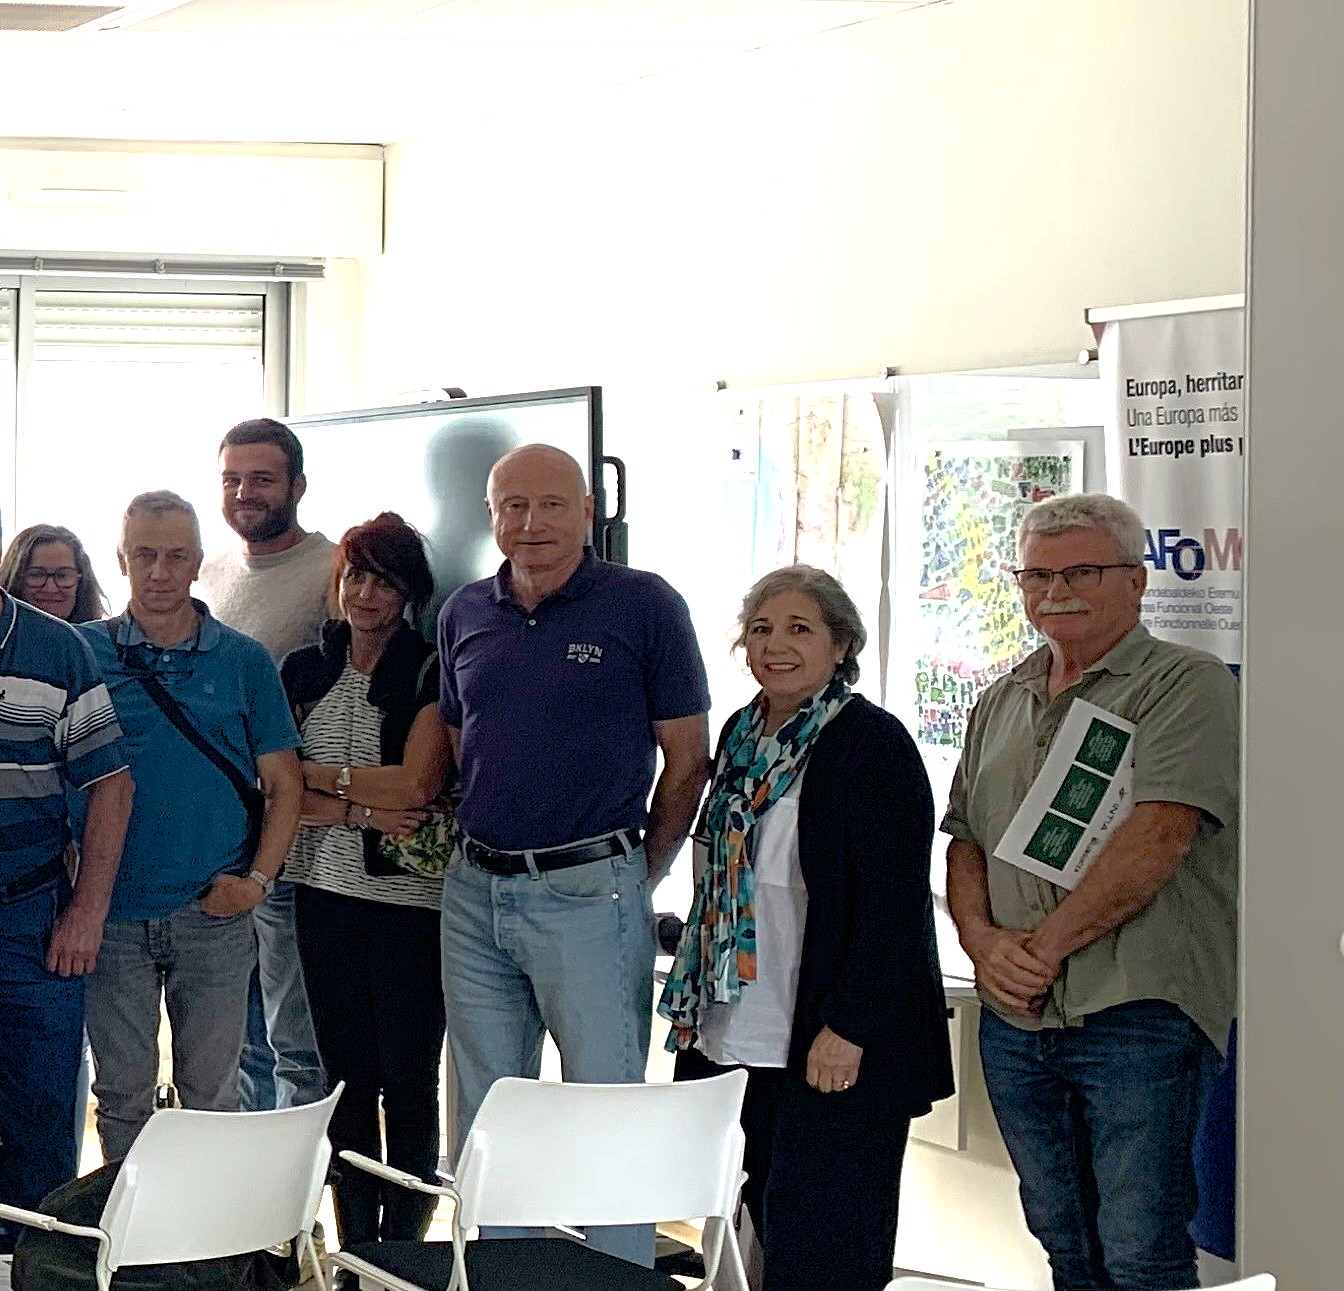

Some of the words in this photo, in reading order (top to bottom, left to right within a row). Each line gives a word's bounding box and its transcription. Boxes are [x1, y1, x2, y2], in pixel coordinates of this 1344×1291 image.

[1126, 378, 1182, 400] Europa,
[1186, 371, 1244, 393] herritar
[1127, 408, 1152, 427] Una
[1156, 406, 1205, 428] Europa
[1209, 401, 1238, 421] más
[1128, 437, 1195, 459] L'Europe
[1200, 434, 1234, 458] plus
[1157, 602, 1202, 613] Funcional
[568, 643, 603, 657] BKLYN
